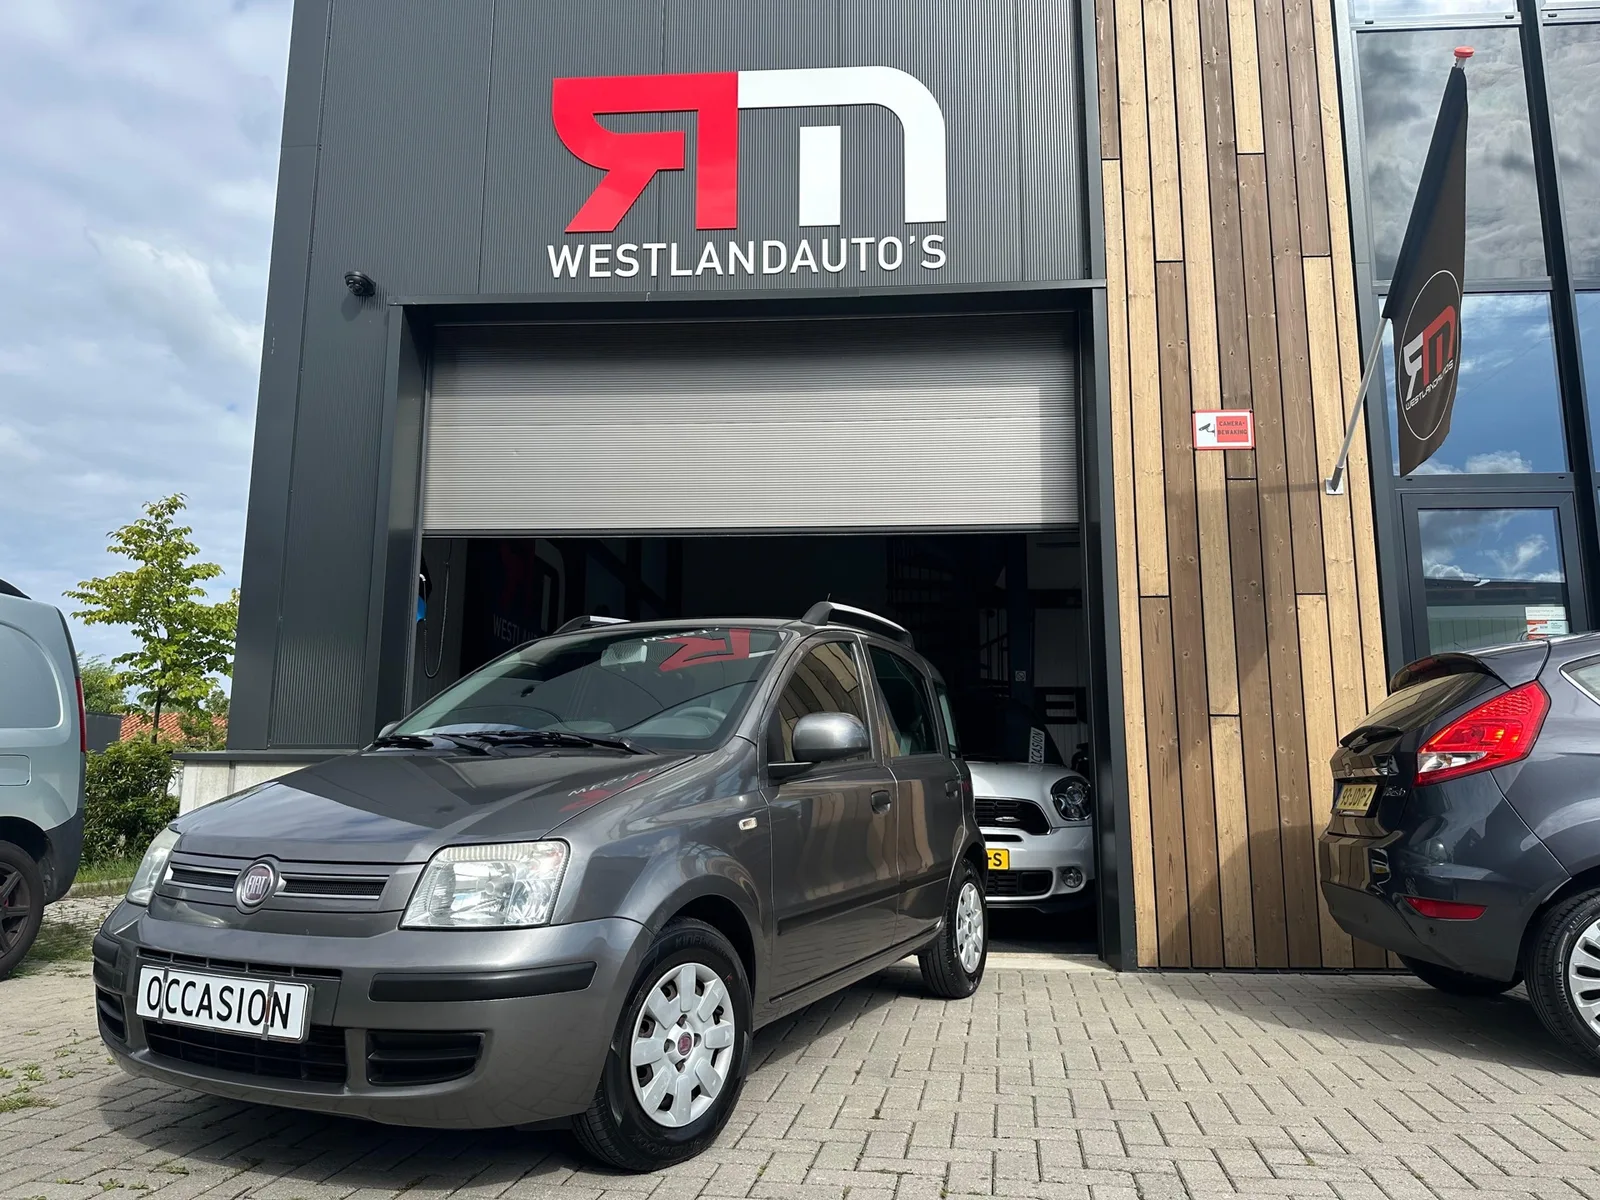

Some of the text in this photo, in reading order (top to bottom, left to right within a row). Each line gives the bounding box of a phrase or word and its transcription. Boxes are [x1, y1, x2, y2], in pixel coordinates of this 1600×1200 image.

[547, 234, 947, 278] WESTLANDAUTO'S
[1217, 428, 1248, 436] BEWAKING
[1031, 729, 1044, 764] CCASION
[246, 875, 268, 895] FIAT
[147, 975, 292, 1029] OCCASION
